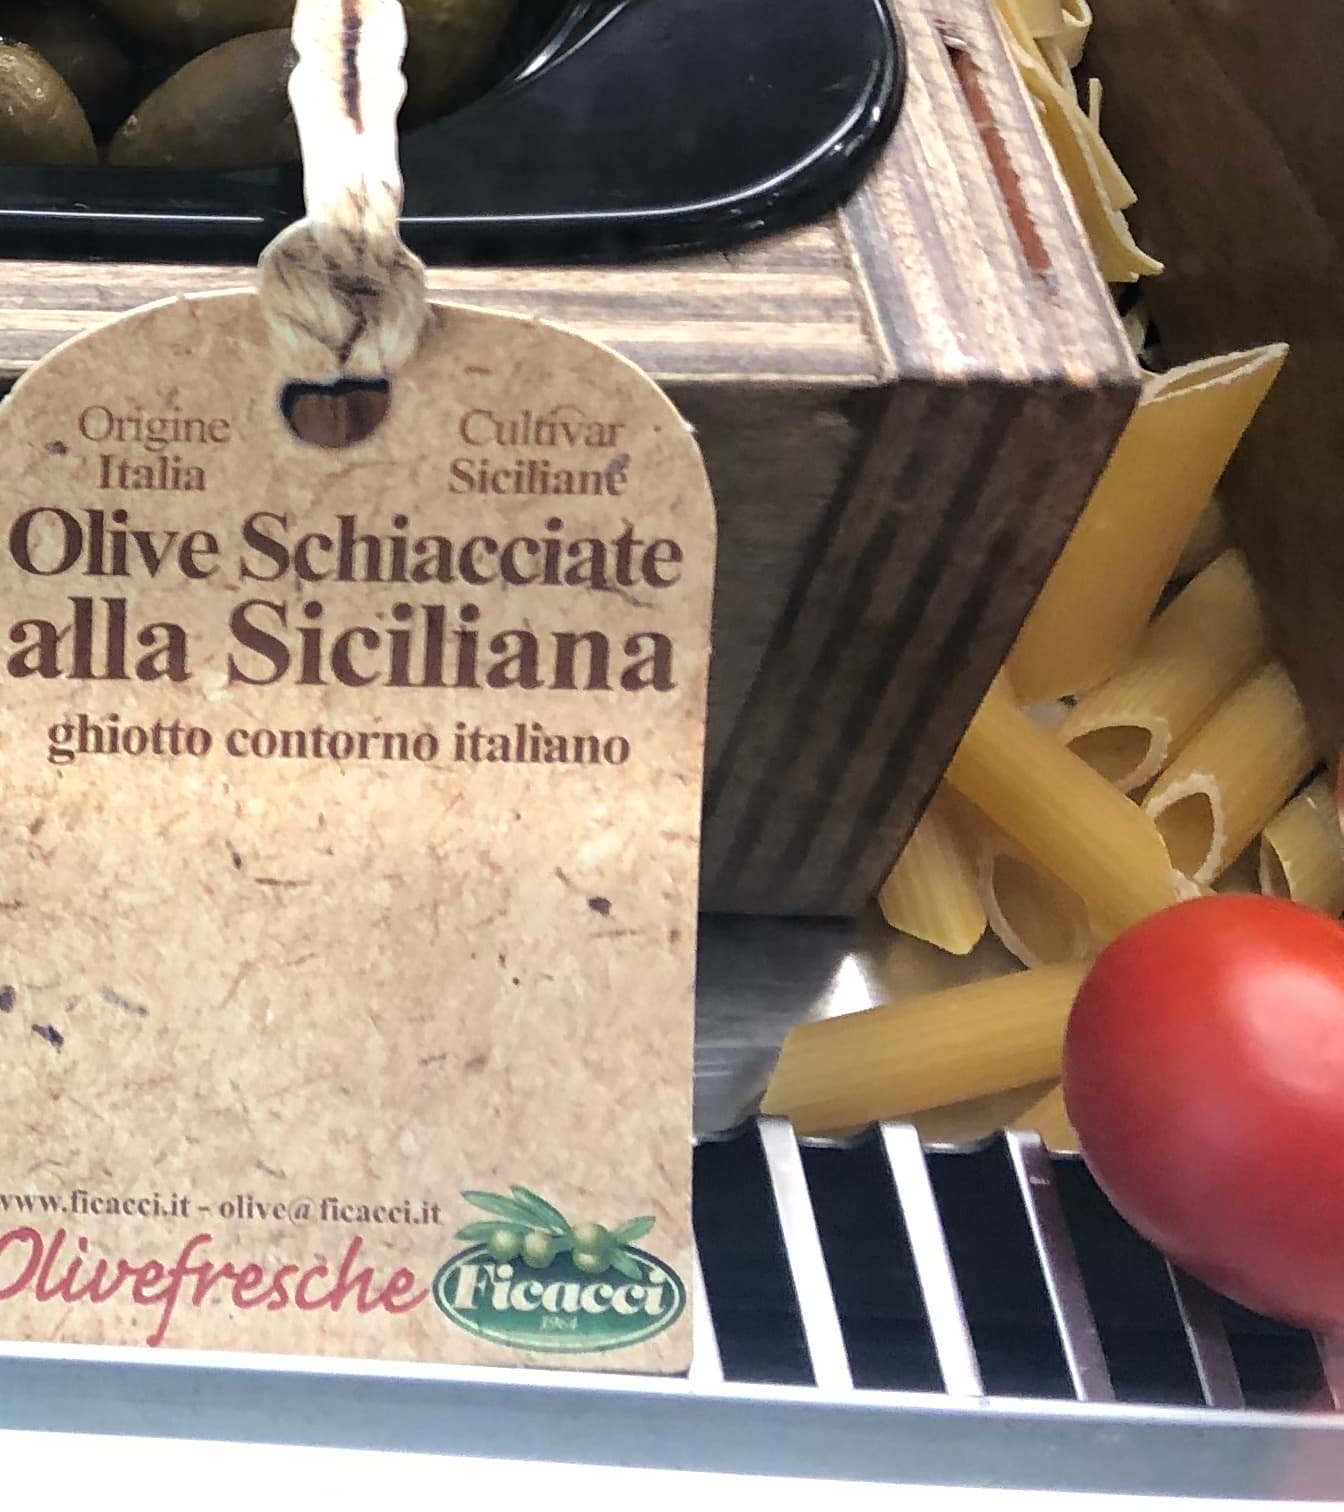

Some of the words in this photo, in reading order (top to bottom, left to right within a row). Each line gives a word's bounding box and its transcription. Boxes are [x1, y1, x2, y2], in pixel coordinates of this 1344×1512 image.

[78, 404, 231, 445] Origine
[459, 408, 626, 449] Cultivar
[97, 452, 206, 492] Italia
[448, 457, 629, 497] Siciliane
[7, 505, 219, 580] Olive
[239, 510, 684, 588] Schiacciate
[6, 596, 192, 683] alla
[227, 597, 676, 693] Siciliana
[47, 712, 214, 765] ghiotto
[225, 722, 439, 761] contorno
[452, 721, 631, 766] italiano
[452, 1261, 669, 1318] Ficacci
